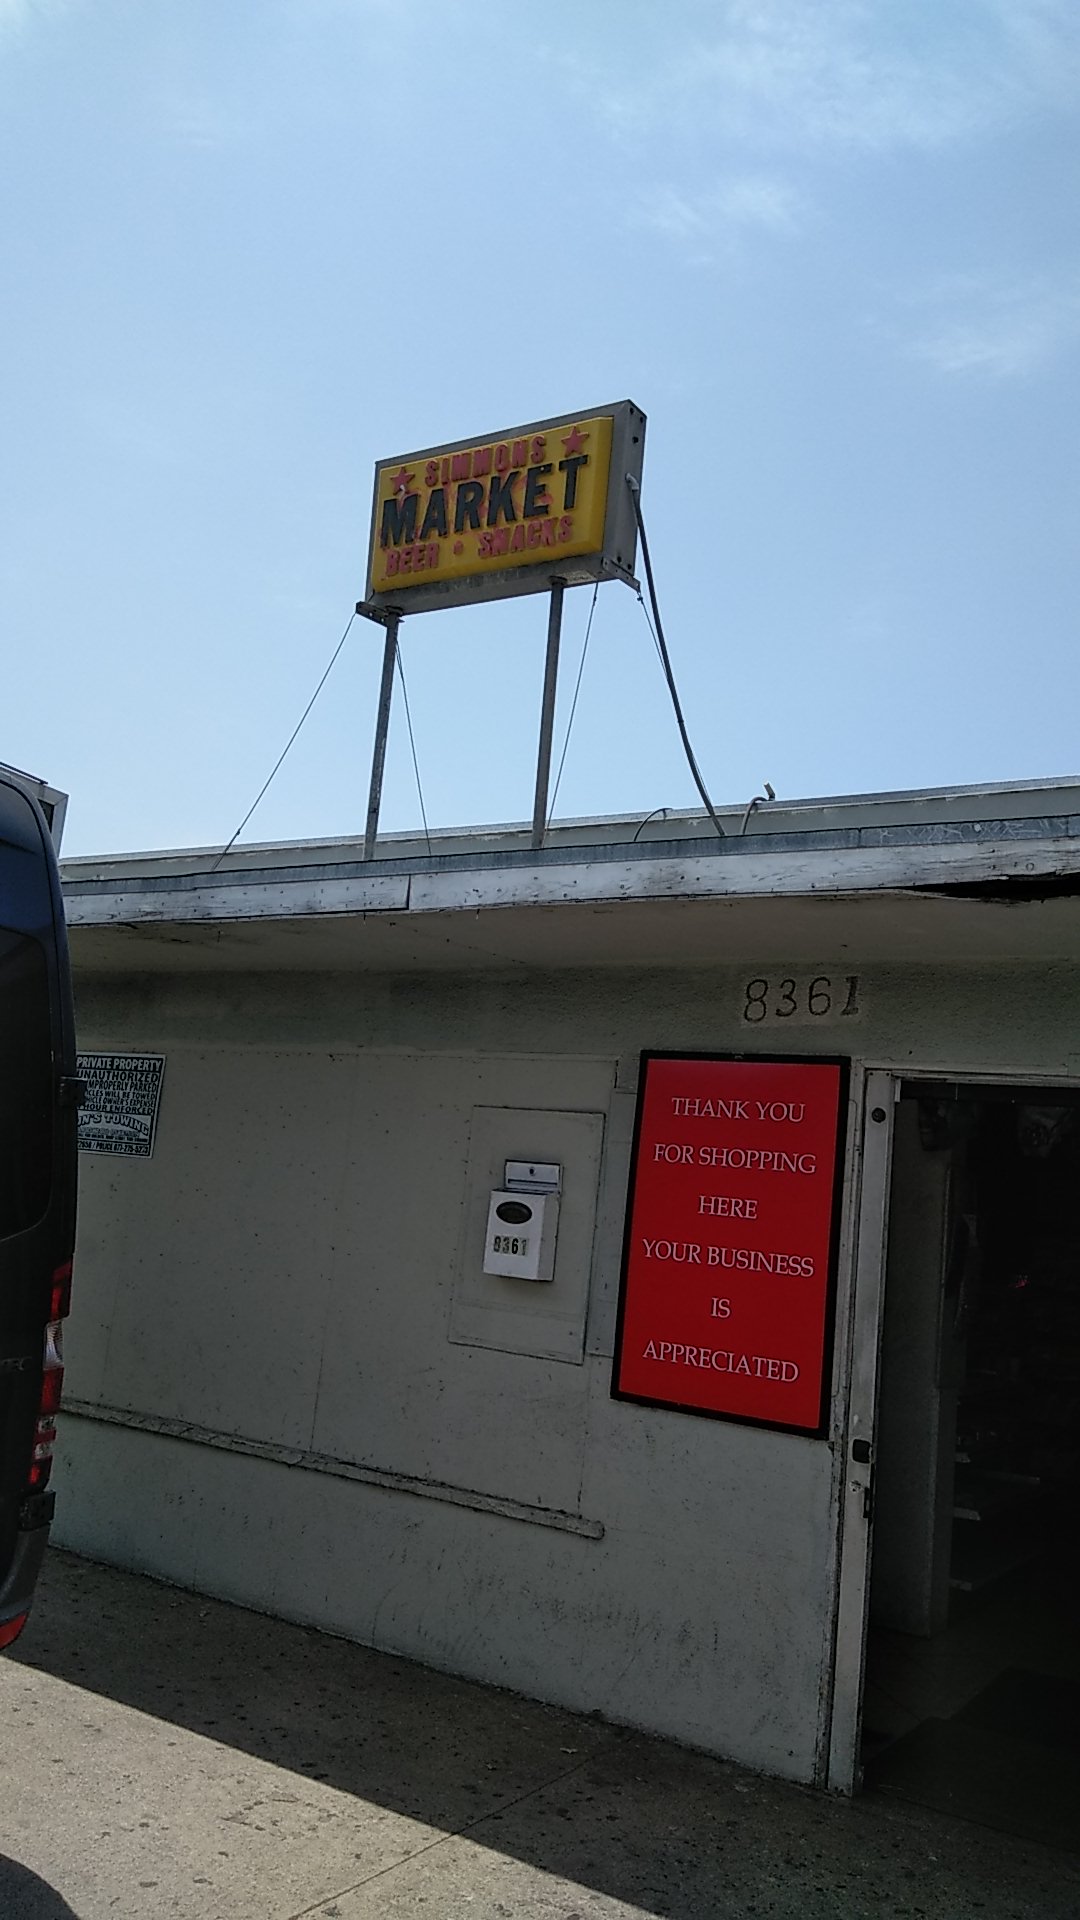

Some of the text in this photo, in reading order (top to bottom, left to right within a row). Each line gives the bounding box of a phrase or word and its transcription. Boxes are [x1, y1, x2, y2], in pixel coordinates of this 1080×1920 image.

[425, 434, 546, 487] SIMMONS
[380, 454, 588, 548] MARKET
[384, 515, 573, 577] BEER SNACKS
[744, 976, 859, 1022] 8361
[77, 1056, 161, 1071] PRIVATE PROPERTY
[78, 1070, 159, 1083] UNAUTHORIZED
[87, 1079, 157, 1093] MPROPERLY PARKED
[104, 1090, 120, 1098] WILL
[122, 1091, 130, 1099] BE
[132, 1091, 155, 1100] TOWED
[109, 1104, 153, 1115] ENFORCED
[671, 1096, 805, 1122] THANK YOU
[103, 1112, 149, 1137] TOWING
[653, 1143, 817, 1174] FOR SHOPPING
[697, 1195, 758, 1219] HERE
[493, 1235, 527, 1256] 8361
[642, 1239, 814, 1277] YOUR BUSINESS
[710, 1298, 731, 1318] IS
[642, 1339, 799, 1382] APPRECIATED
